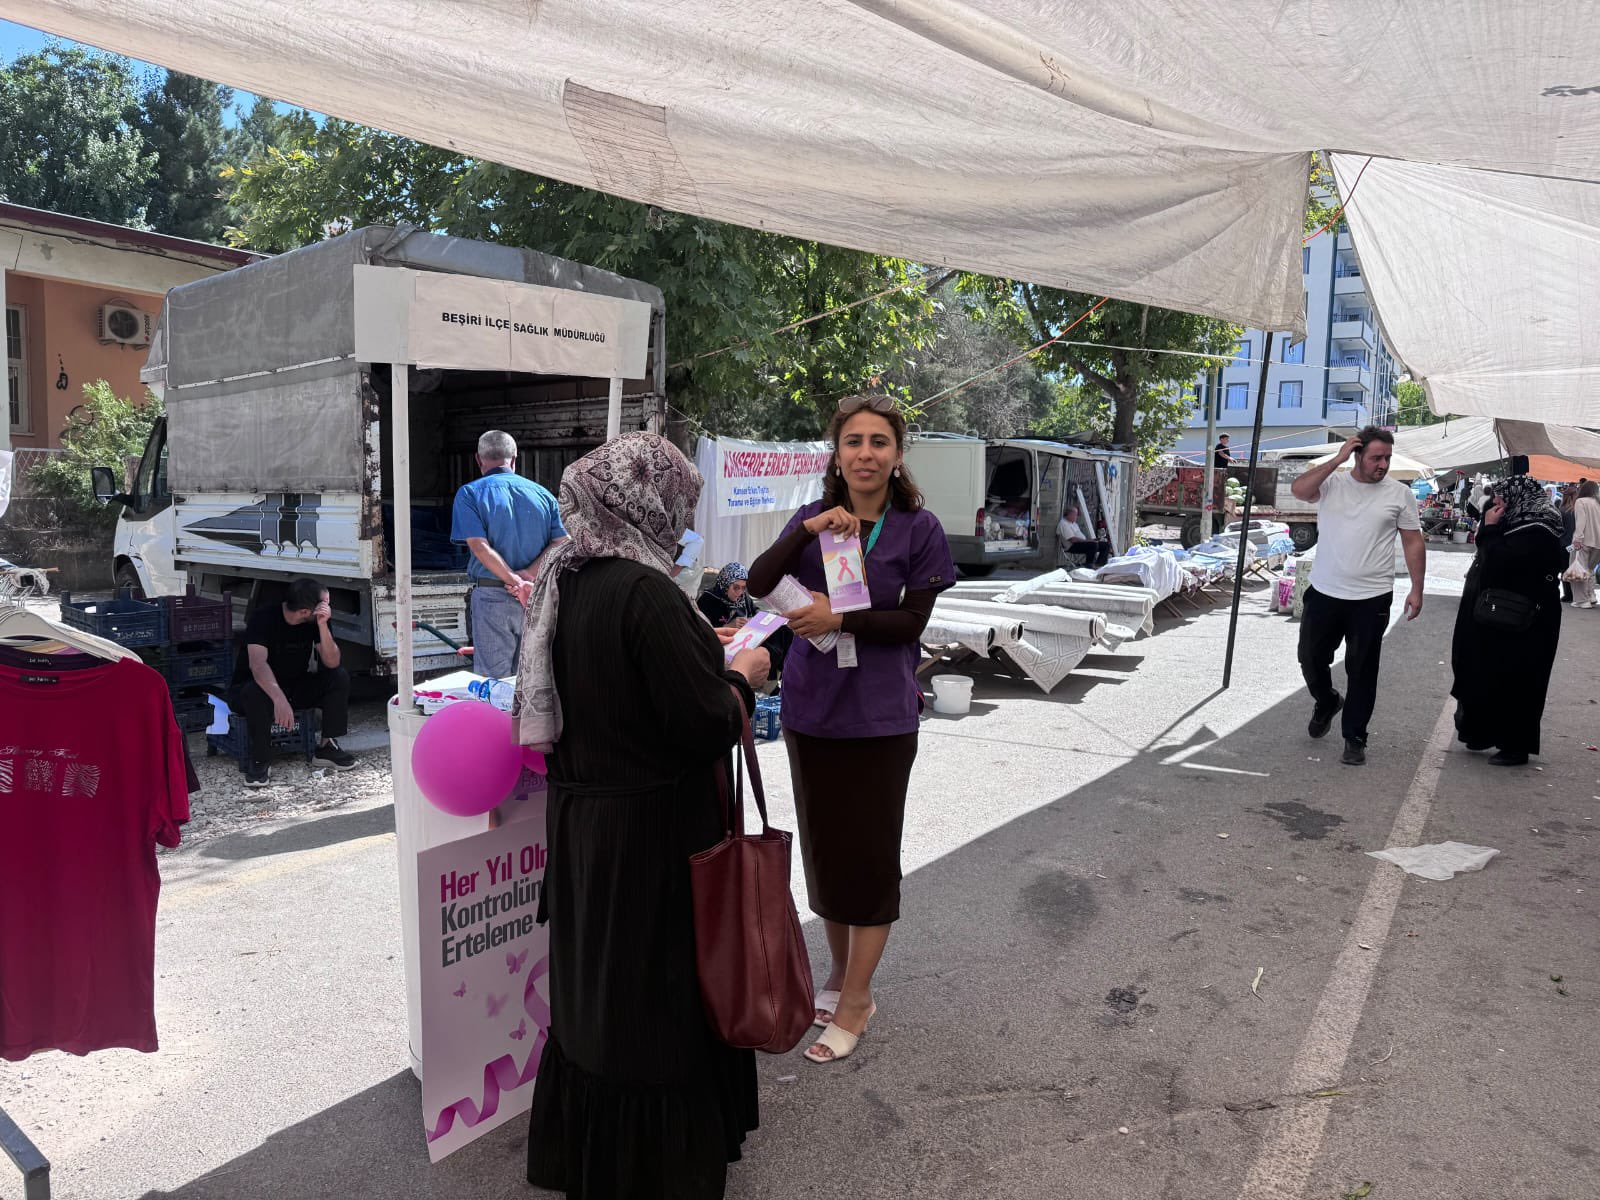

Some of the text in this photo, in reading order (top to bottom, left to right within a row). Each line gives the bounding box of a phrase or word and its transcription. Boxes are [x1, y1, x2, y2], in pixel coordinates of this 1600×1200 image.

[441, 312, 606, 343] BEŞİRİ İLÇE SAĞLIK MÜDÜRLÜĞÜ
[723, 449, 767, 478] KANSERDE
[764, 451, 792, 477] ERKEN
[440, 870, 480, 903] Her
[486, 852, 512, 886] Yıl
[441, 877, 543, 935] Kontrolün
[442, 913, 533, 968] Erteleme
